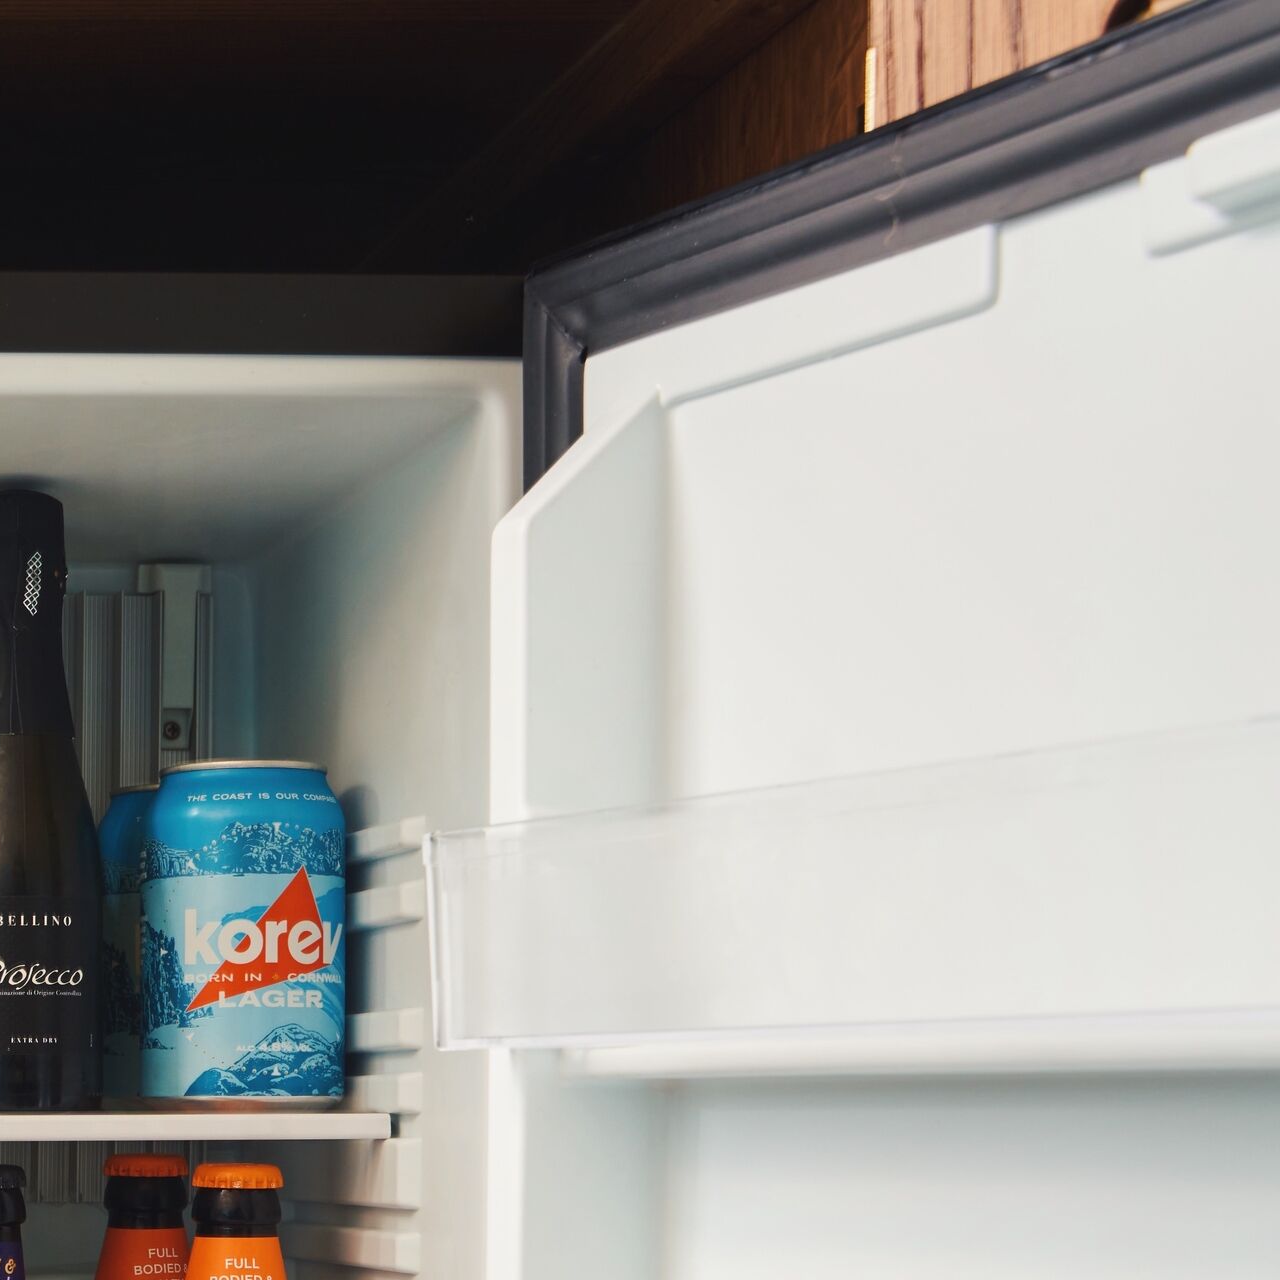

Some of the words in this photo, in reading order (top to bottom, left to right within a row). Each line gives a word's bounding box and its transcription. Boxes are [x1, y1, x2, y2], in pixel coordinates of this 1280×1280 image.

[187, 794, 207, 802] THE
[212, 793, 253, 801] COAST
[184, 909, 343, 965] korev
[184, 973, 234, 983] BORN
[244, 973, 262, 982] IN
[287, 972, 341, 983] CORNWALL
[218, 990, 323, 1008] LAGER
[148, 1248, 179, 1258] FULL
[5, 1258, 17, 1274] &
[225, 1257, 260, 1269] FULL
[134, 1263, 182, 1276] BODIED
